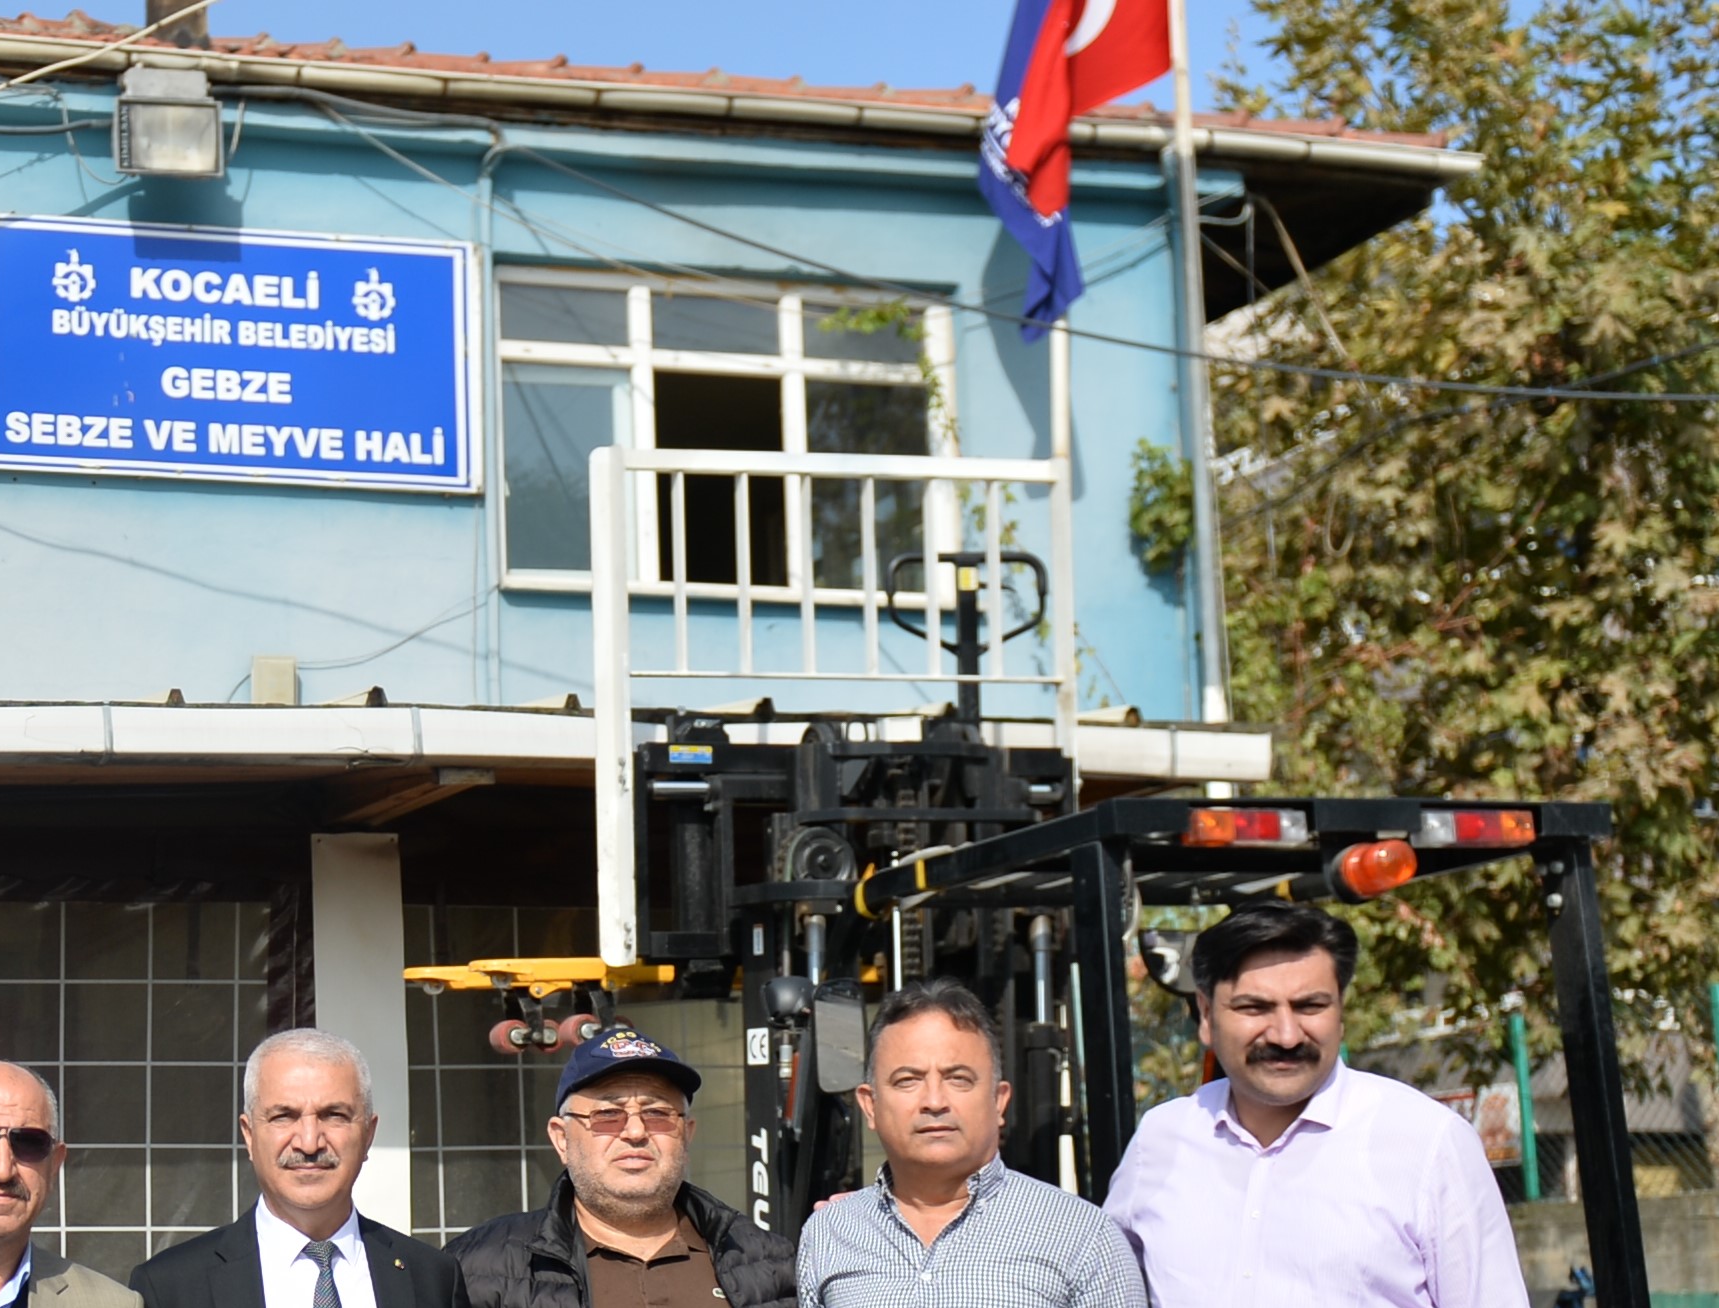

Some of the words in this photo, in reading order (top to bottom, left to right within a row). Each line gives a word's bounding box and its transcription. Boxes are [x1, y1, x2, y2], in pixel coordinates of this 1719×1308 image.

[130, 267, 320, 310] KOCAELİ
[51, 306, 232, 347] BÜYÜKŞEHİR
[237, 319, 396, 355] BELEDİYESİ
[161, 367, 293, 404] GEBZE
[5, 412, 134, 449] SEBZE
[143, 420, 197, 453] VE
[208, 423, 345, 460] MEYVE
[355, 427, 445, 466] HALİ
